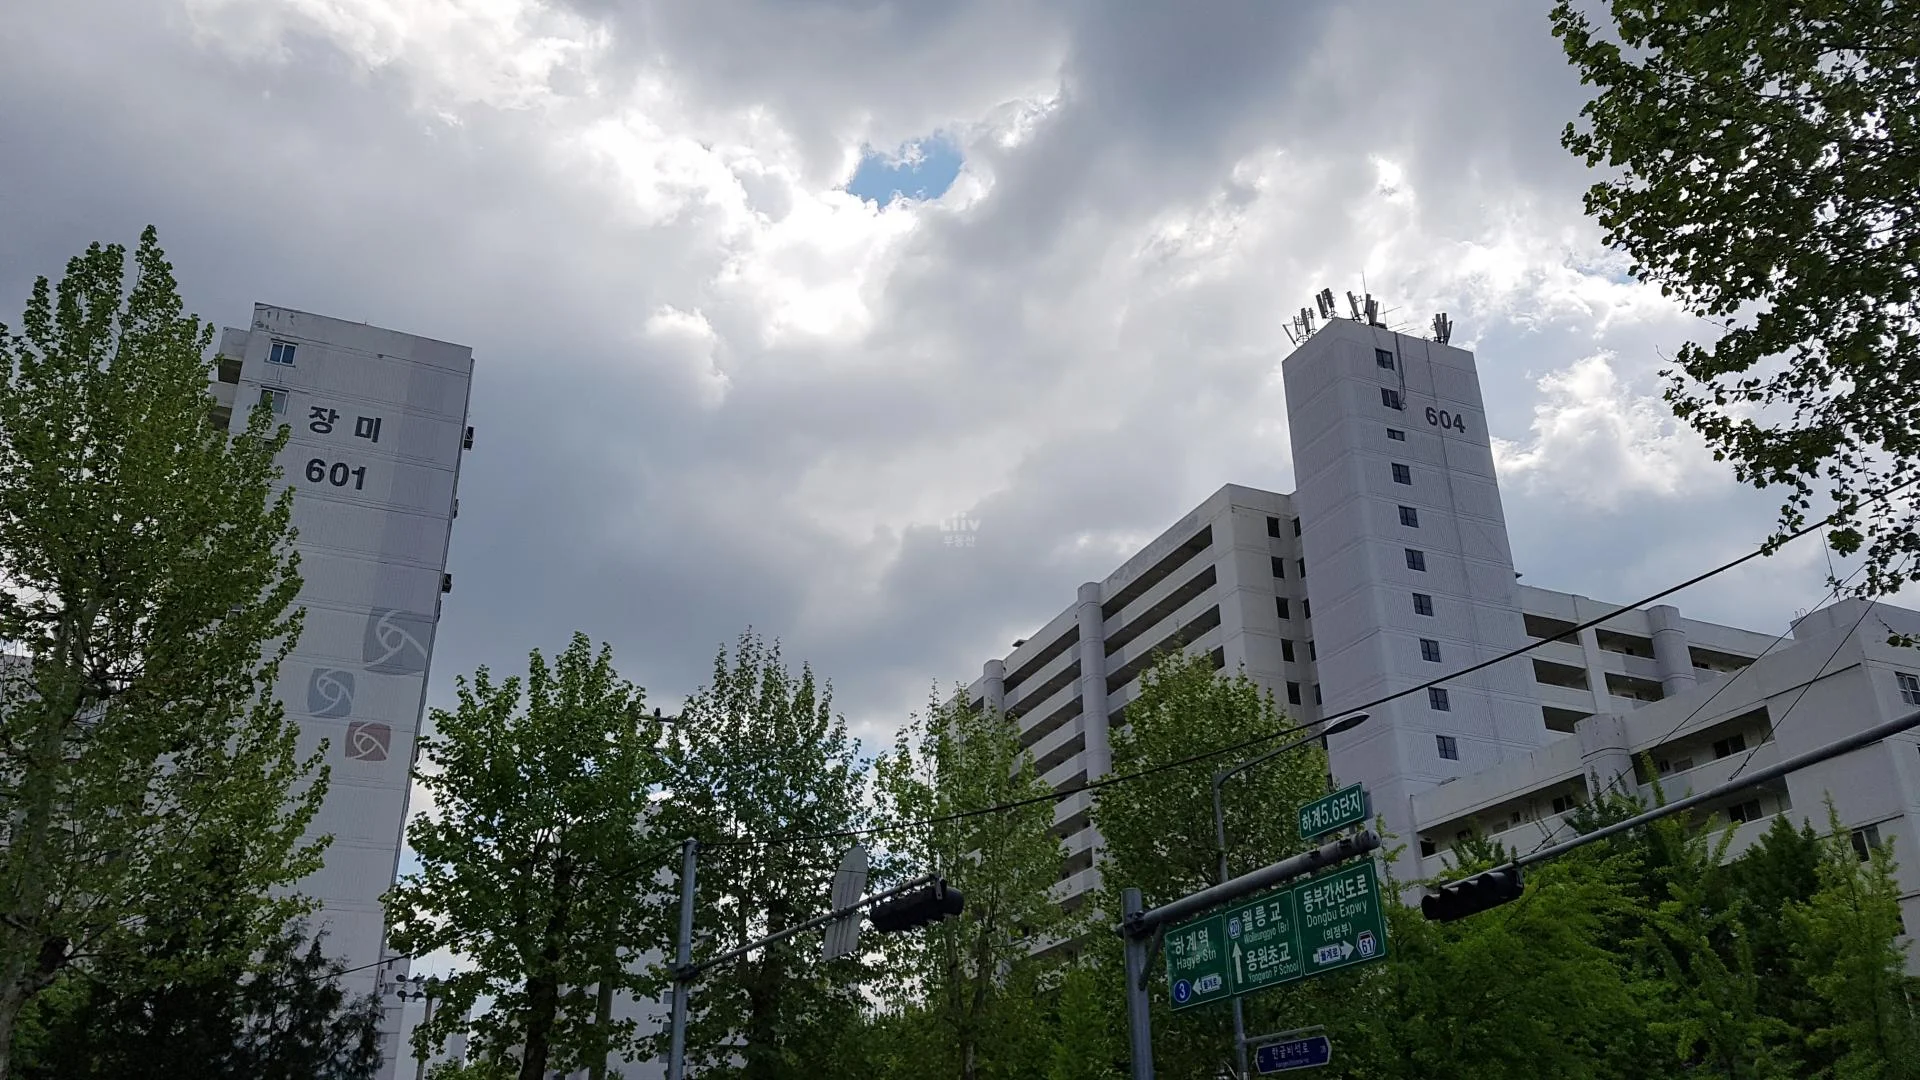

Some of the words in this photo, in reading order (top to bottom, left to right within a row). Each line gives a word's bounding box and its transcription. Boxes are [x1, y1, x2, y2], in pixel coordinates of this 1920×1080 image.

[308, 405, 382, 443] 장미
[1425, 406, 1466, 433] 604
[305, 458, 367, 490] 601
[1301, 789, 1361, 831] 하계5.6단지
[1303, 873, 1369, 913] 동부간선도로
[1242, 902, 1282, 931] 월릉교
[1306, 908, 1337, 928] Dongbu
[1339, 900, 1368, 918] Expwy
[1173, 926, 1210, 956] 하계역
[1323, 921, 1353, 942] (의정부)
[1176, 953, 1201, 971] Hagye
[1202, 947, 1217, 962] Stn
[1246, 942, 1292, 972] 용원초교
[1361, 938, 1373, 954] 61
[1279, 959, 1299, 976] School
[1179, 983, 1186, 999] 3
